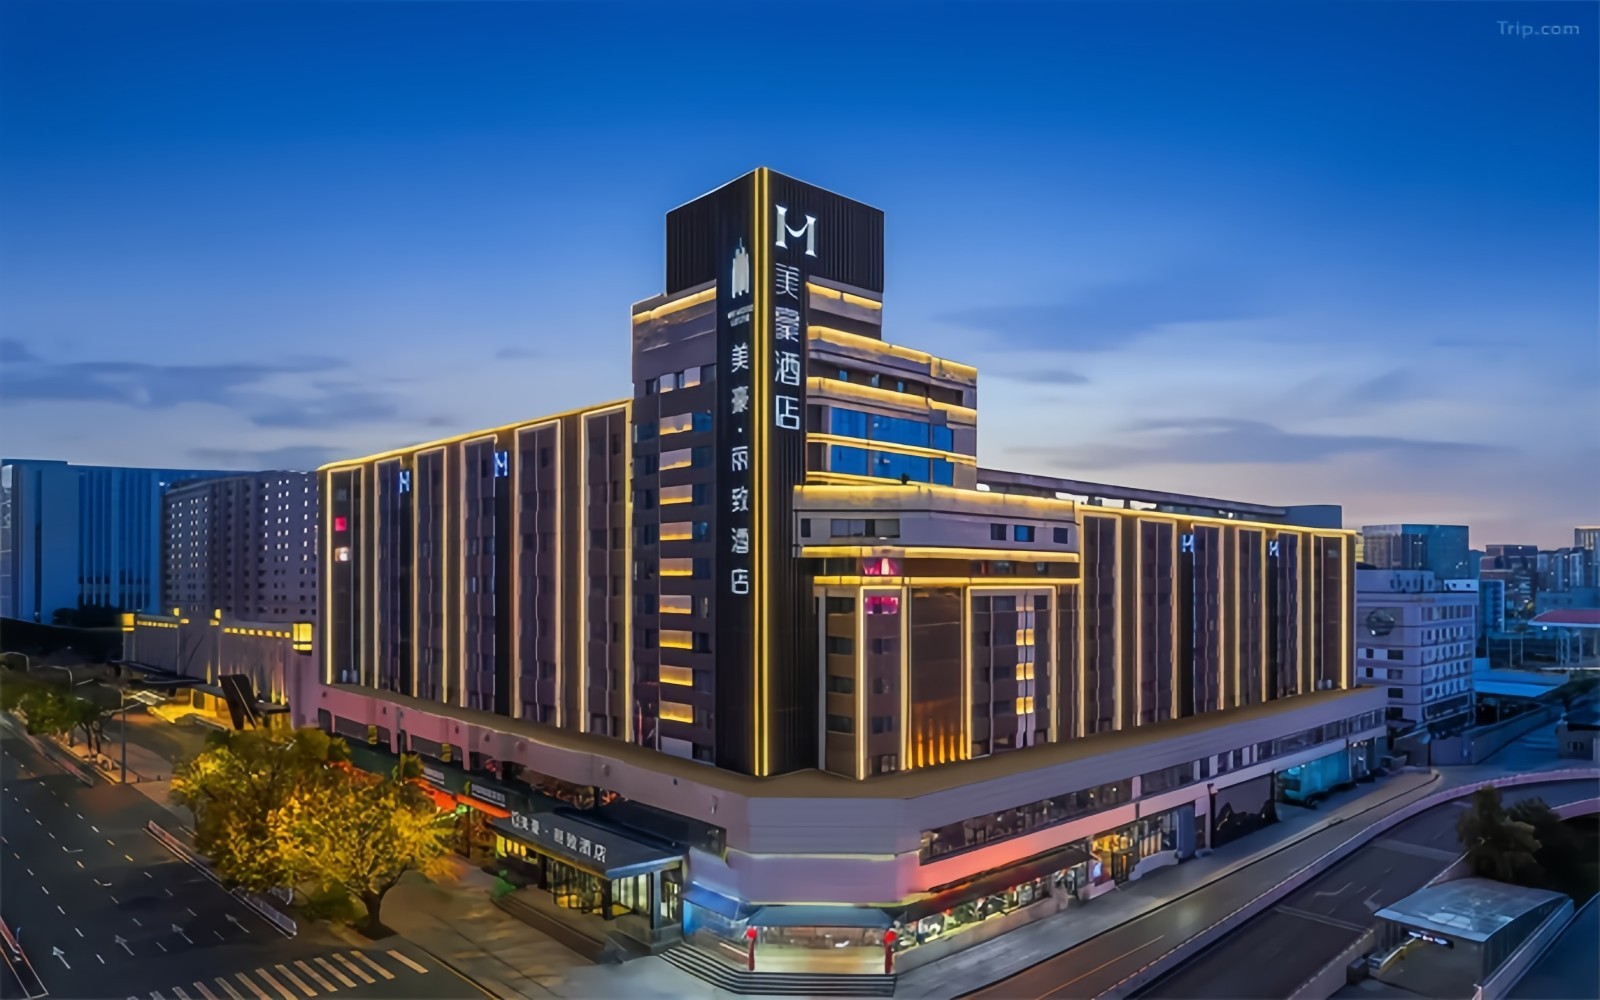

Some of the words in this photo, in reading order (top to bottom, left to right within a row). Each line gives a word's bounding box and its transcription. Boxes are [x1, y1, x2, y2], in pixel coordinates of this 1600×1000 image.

[775, 204, 818, 258] M
[775, 262, 800, 431] 美豪酒店
